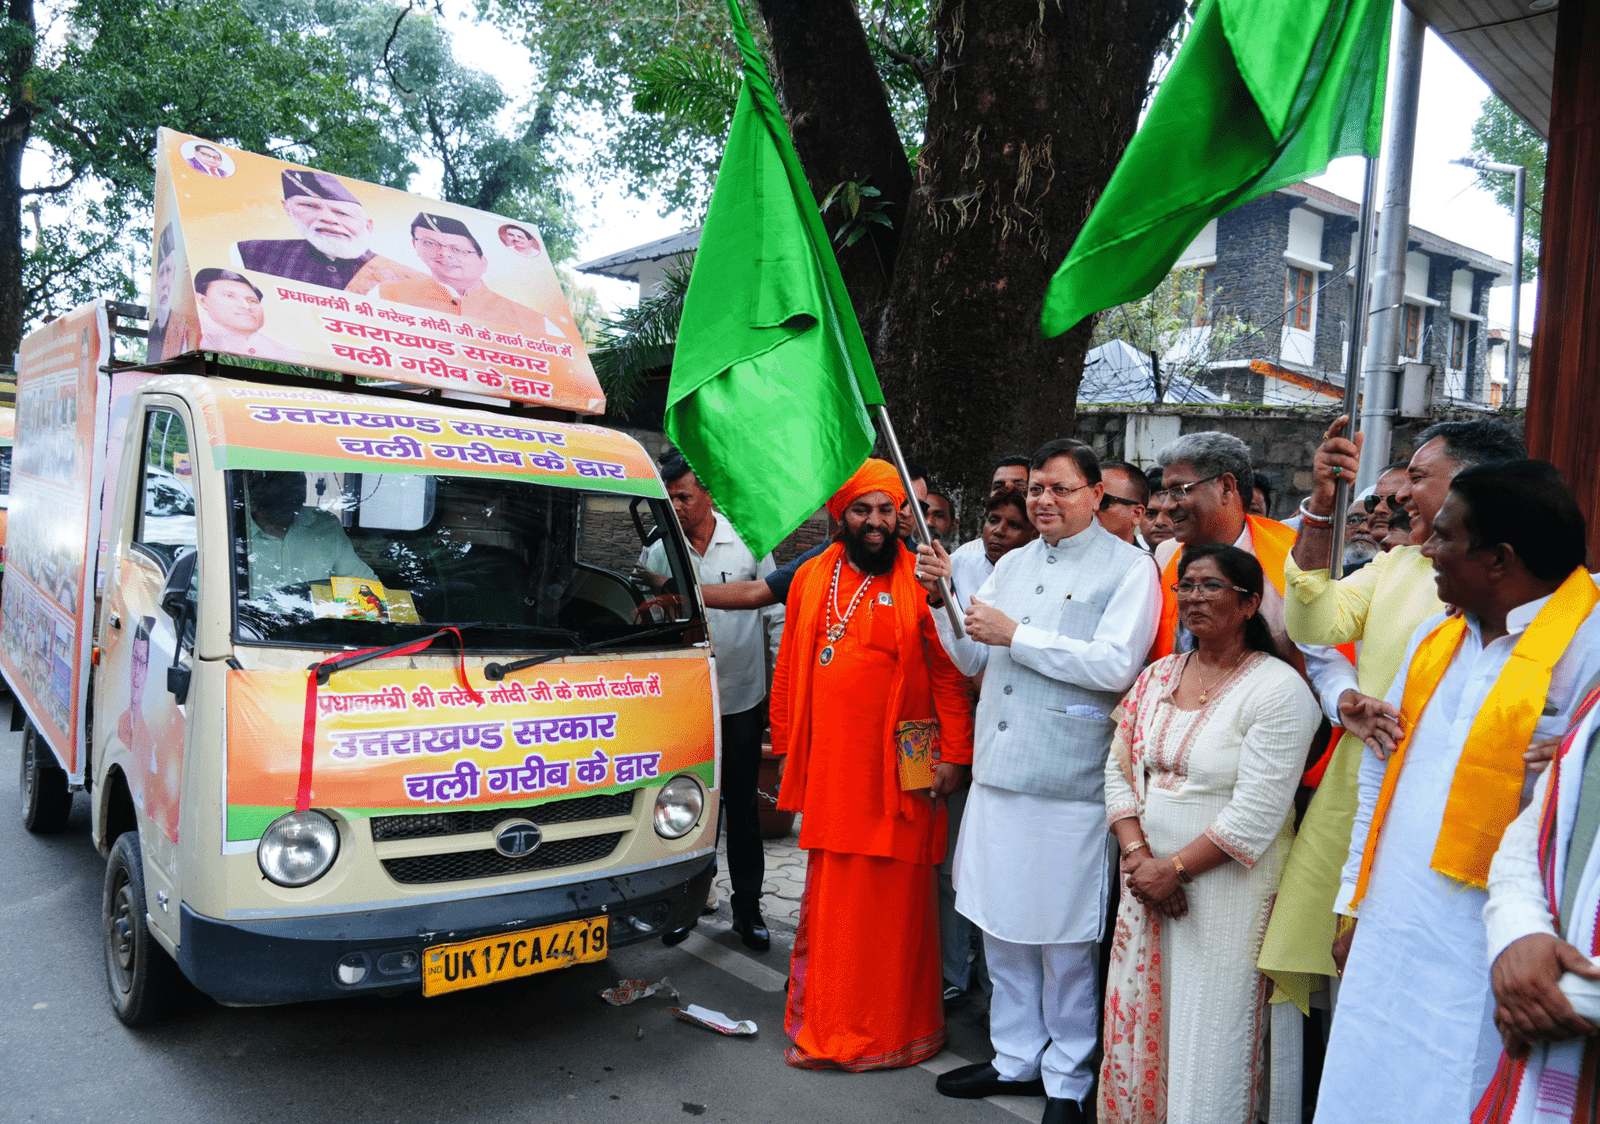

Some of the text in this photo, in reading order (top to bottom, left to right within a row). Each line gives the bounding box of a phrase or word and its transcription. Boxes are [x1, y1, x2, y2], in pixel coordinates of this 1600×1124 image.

[276, 287, 573, 358] प्रधानमंत्री श्री नरेन्द्र मोदी जी के मार्ग दर्शन में
[322, 316, 548, 374] उत्तराखण्ड सरकार
[331, 343, 551, 398] चली गरीब के द्वार
[249, 404, 441, 434] उत्तराखण्ड
[450, 420, 566, 447] सरकार
[340, 435, 625, 479] चली गरीब के द्वार
[317, 686, 407, 717] प्रधानमंत्री
[411, 685, 436, 708] श्री
[487, 682, 528, 704] मोदी
[528, 680, 553, 701] जी
[554, 680, 573, 700] के
[574, 677, 609, 699] मार्ग
[609, 675, 646, 697] दर्शन
[646, 675, 661, 695] में
[331, 714, 617, 759] उत्तराखण्ड सरकार
[405, 750, 661, 801] चली गरीब के द्वार
[428, 965, 443, 976] IND
[444, 926, 605, 982] UK17CA4419
